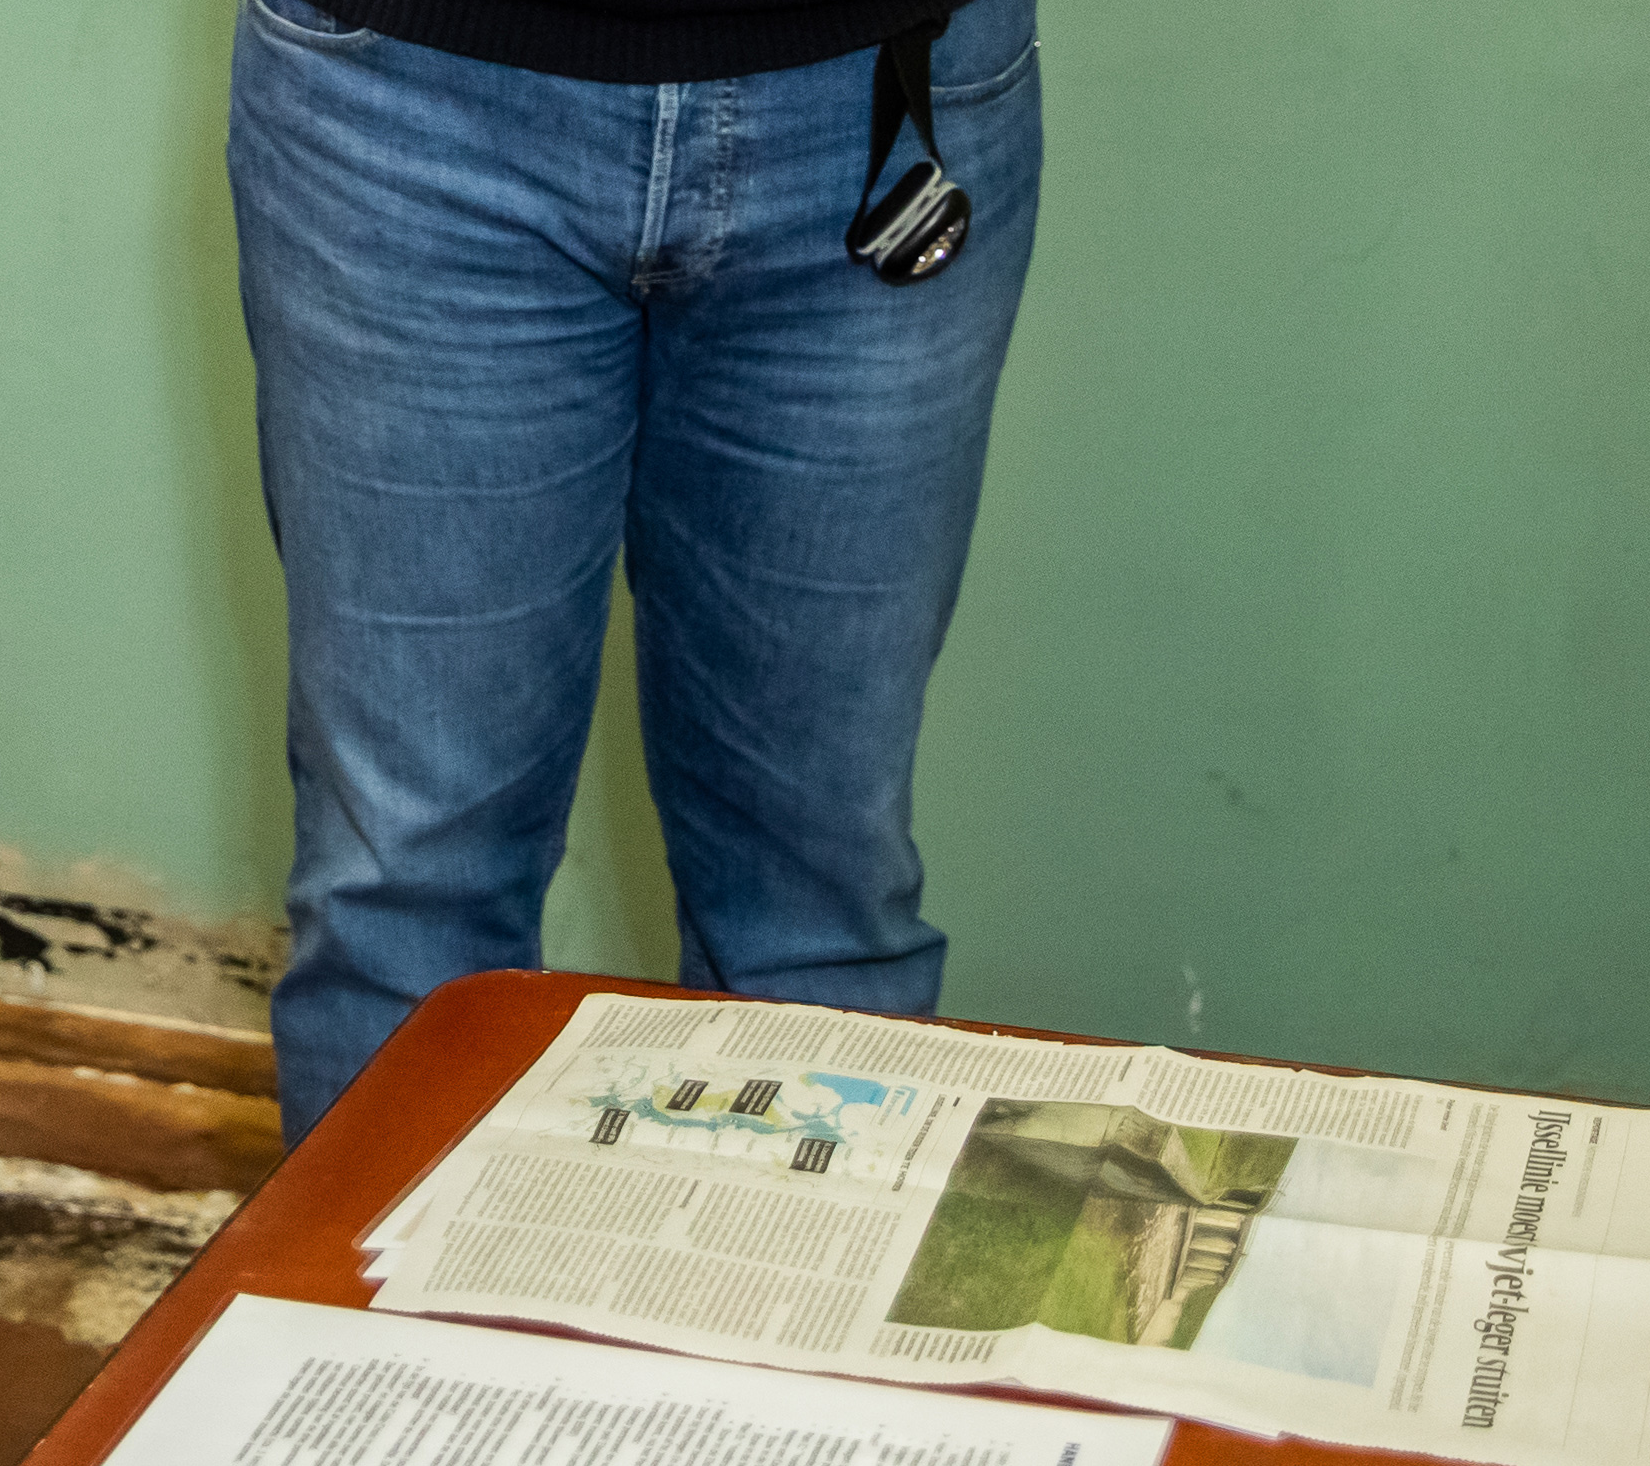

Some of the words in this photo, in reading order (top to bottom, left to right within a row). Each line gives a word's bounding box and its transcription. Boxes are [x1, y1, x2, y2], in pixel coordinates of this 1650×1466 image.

[1520, 1109, 1572, 1193] IJssellinie
[1506, 1194, 1545, 1240] moest
[1473, 1241, 1538, 1357] vjet-leger
[1462, 1356, 1510, 1429] stuiten
